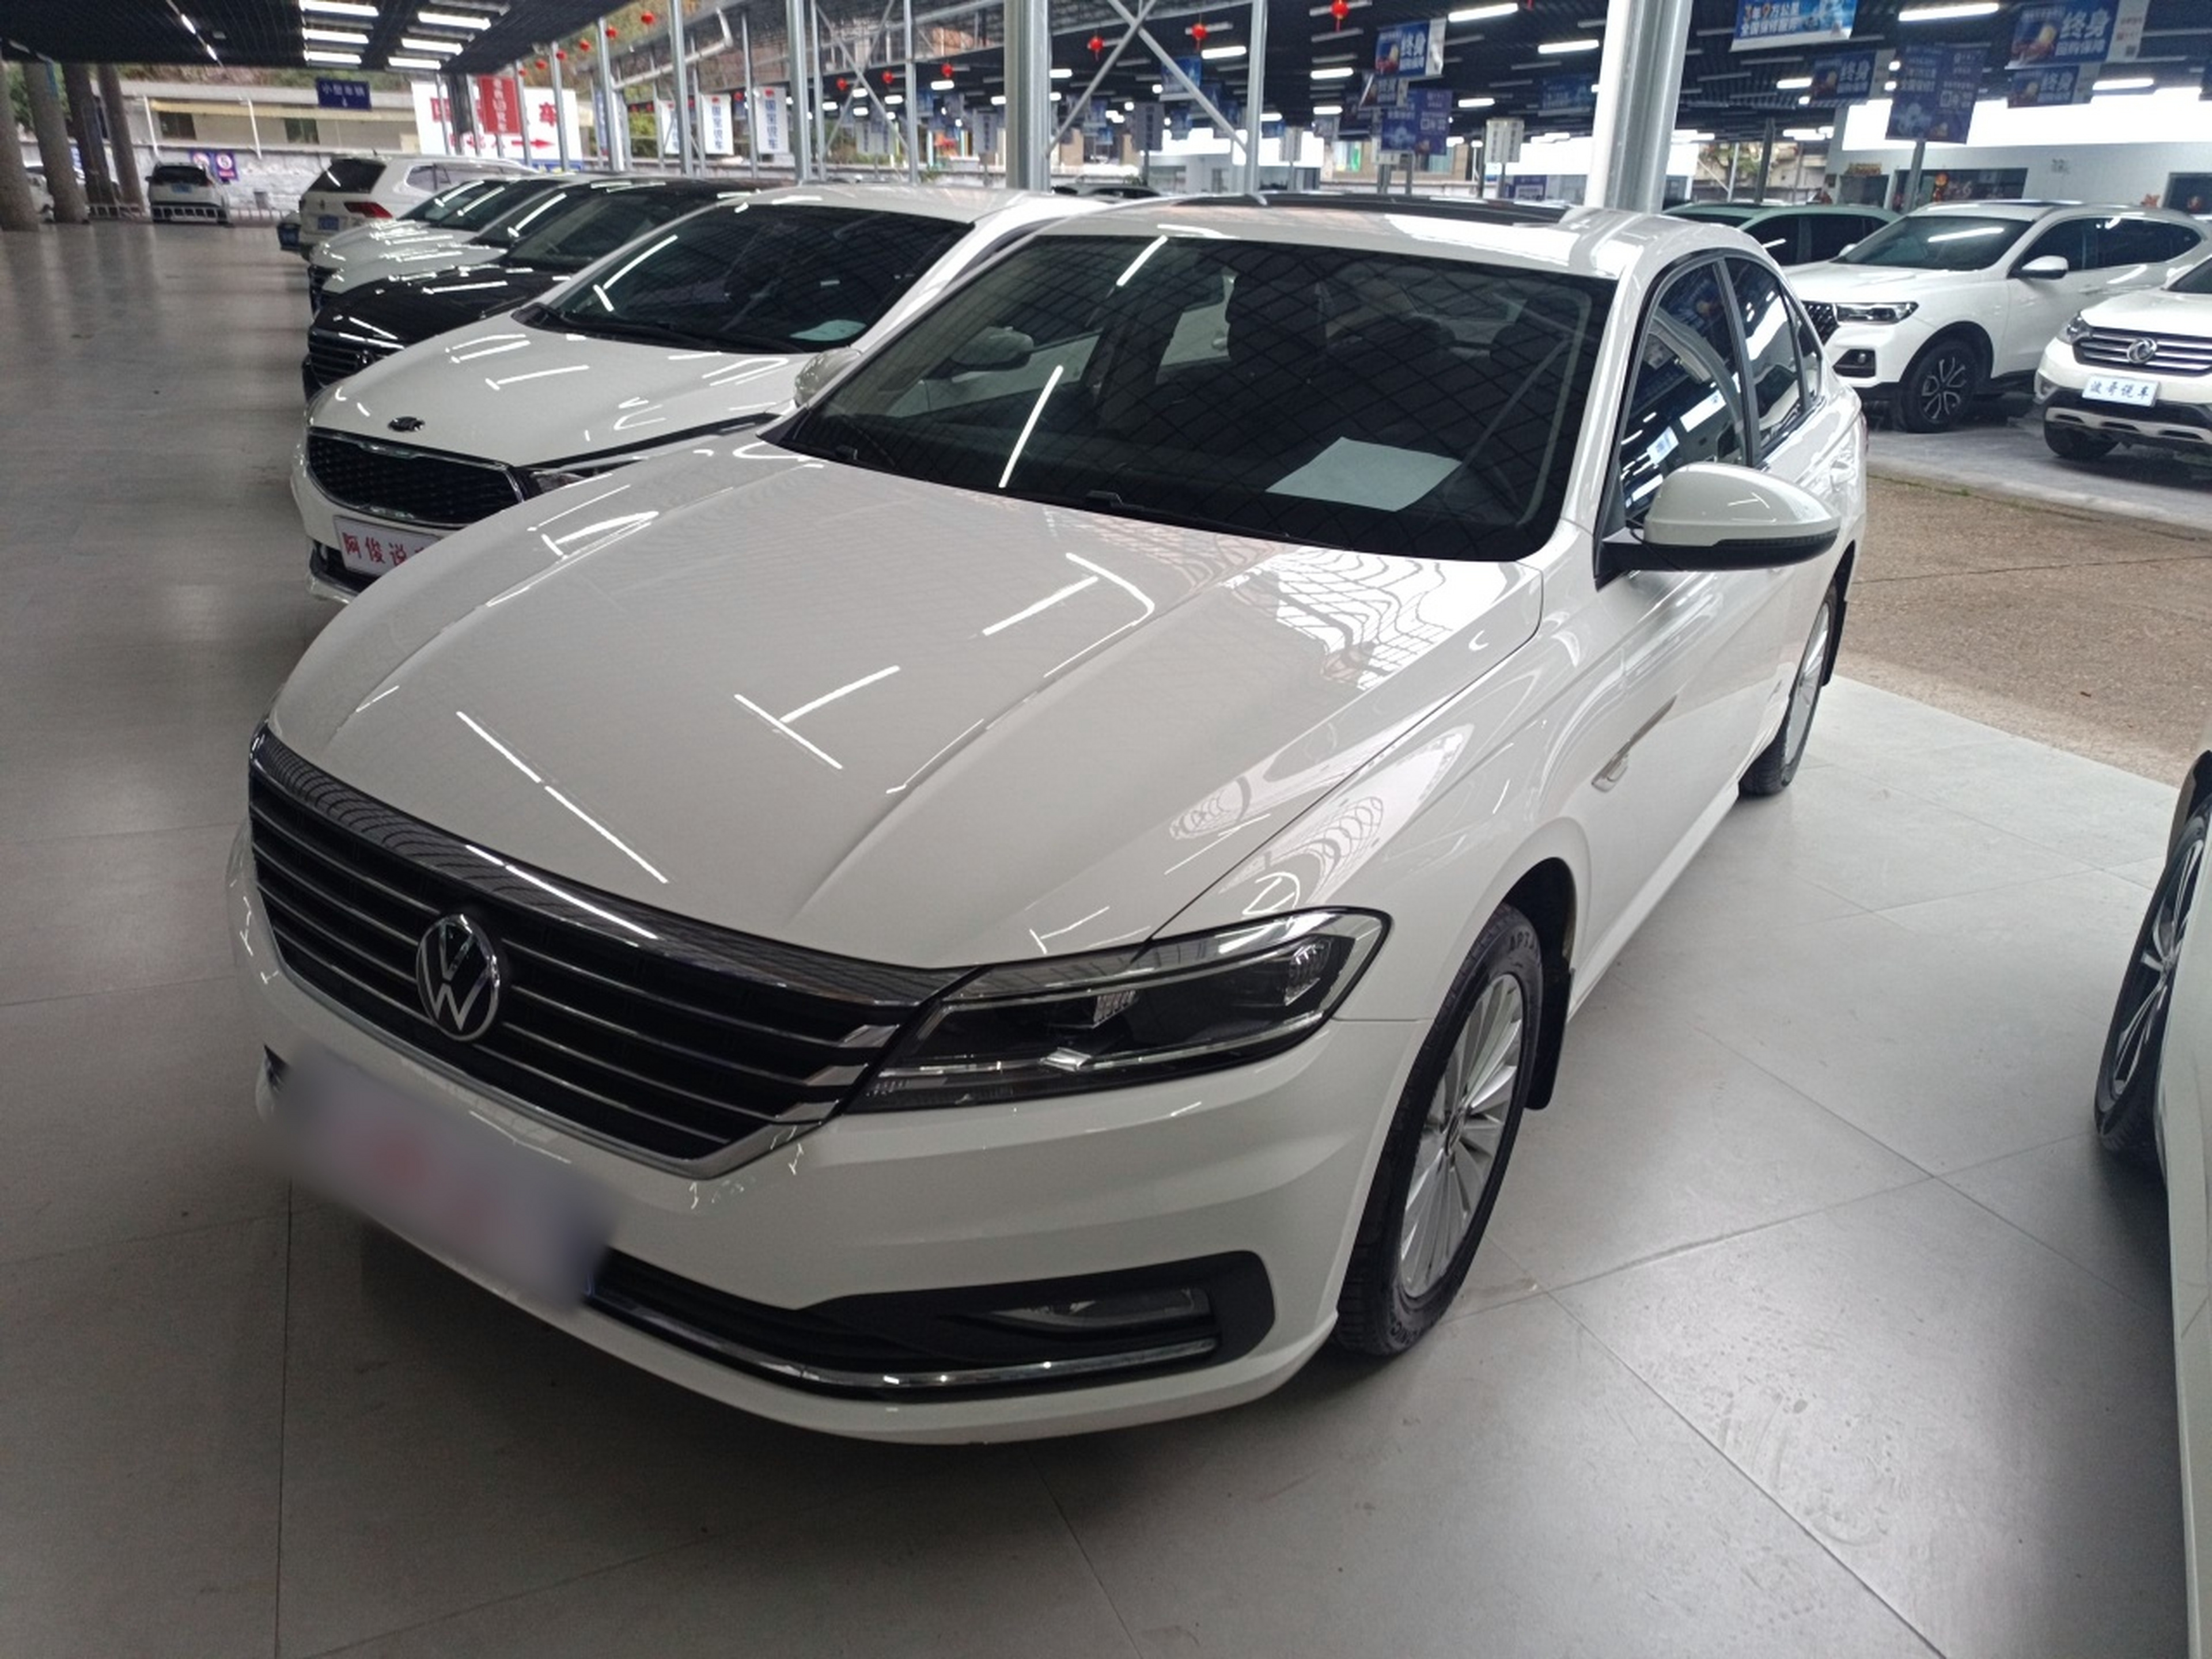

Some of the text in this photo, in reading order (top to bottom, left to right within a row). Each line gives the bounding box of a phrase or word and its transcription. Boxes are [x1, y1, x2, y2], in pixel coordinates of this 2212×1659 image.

[2059, 8, 2111, 40] 终身
[1401, 31, 1426, 56] 终身
[342, 532, 425, 567] 阿俊说
